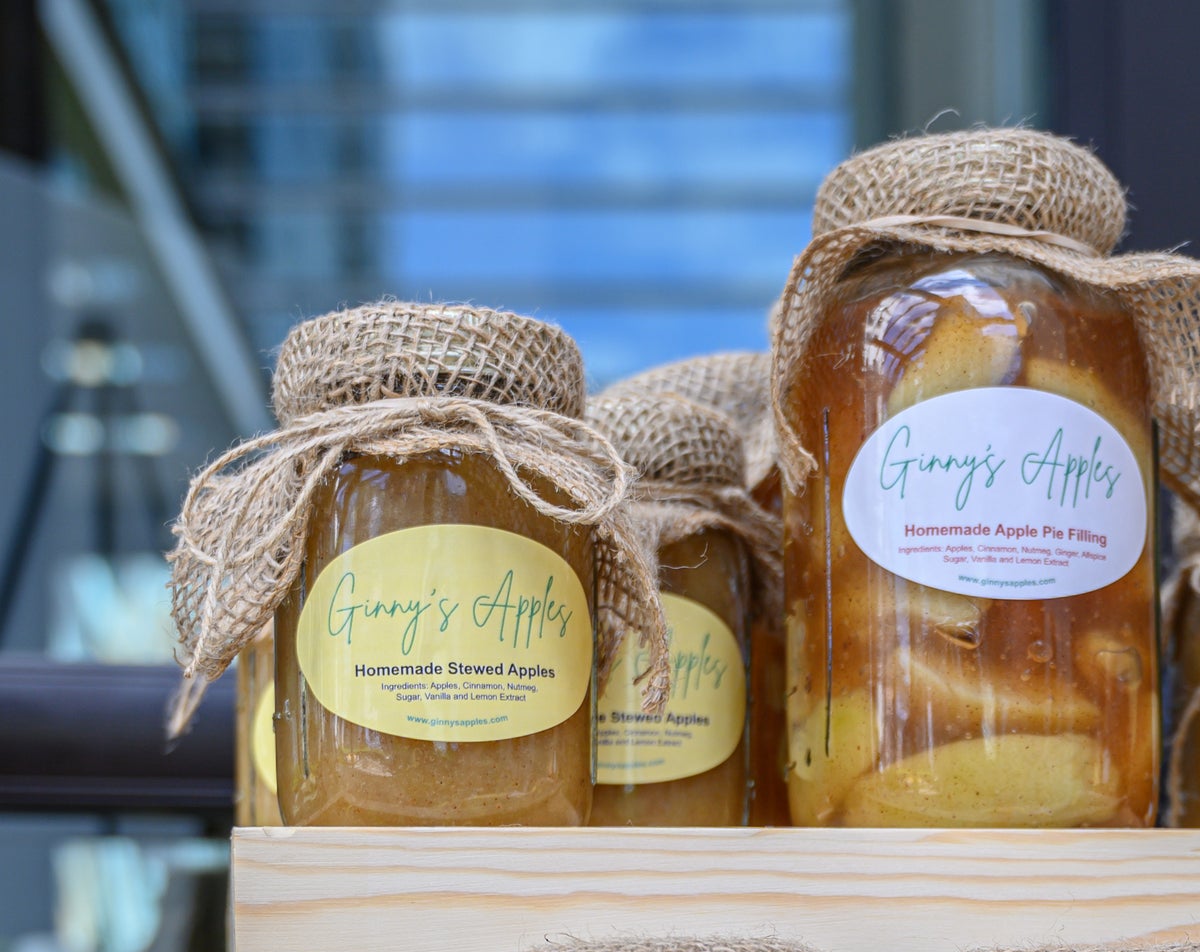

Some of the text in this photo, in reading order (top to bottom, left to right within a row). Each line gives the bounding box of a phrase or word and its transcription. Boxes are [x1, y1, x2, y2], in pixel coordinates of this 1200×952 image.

[880, 425, 1122, 511] Ginny's Apples
[905, 525, 1107, 547] Homemade Apple Pie Filling
[899, 546, 943, 555] Ingredients:
[971, 556, 997, 564] Vanilla
[999, 556, 1014, 564] and
[1016, 557, 1042, 565] Lemon
[1044, 558, 1069, 567] Extract
[958, 575, 1056, 588] www.ginnysapples.com
[327, 569, 573, 655] Ginny's Apples
[354, 661, 556, 680] Homemade Stewed Apples
[381, 681, 539, 693] Ingredients: Apples, Cinnamon, Nutmeg,
[396, 692, 527, 702] Sugar, Vanilla and Lemon Extract
[406, 714, 509, 726] www.ginnysapples.com
[666, 714, 710, 726] Apples
